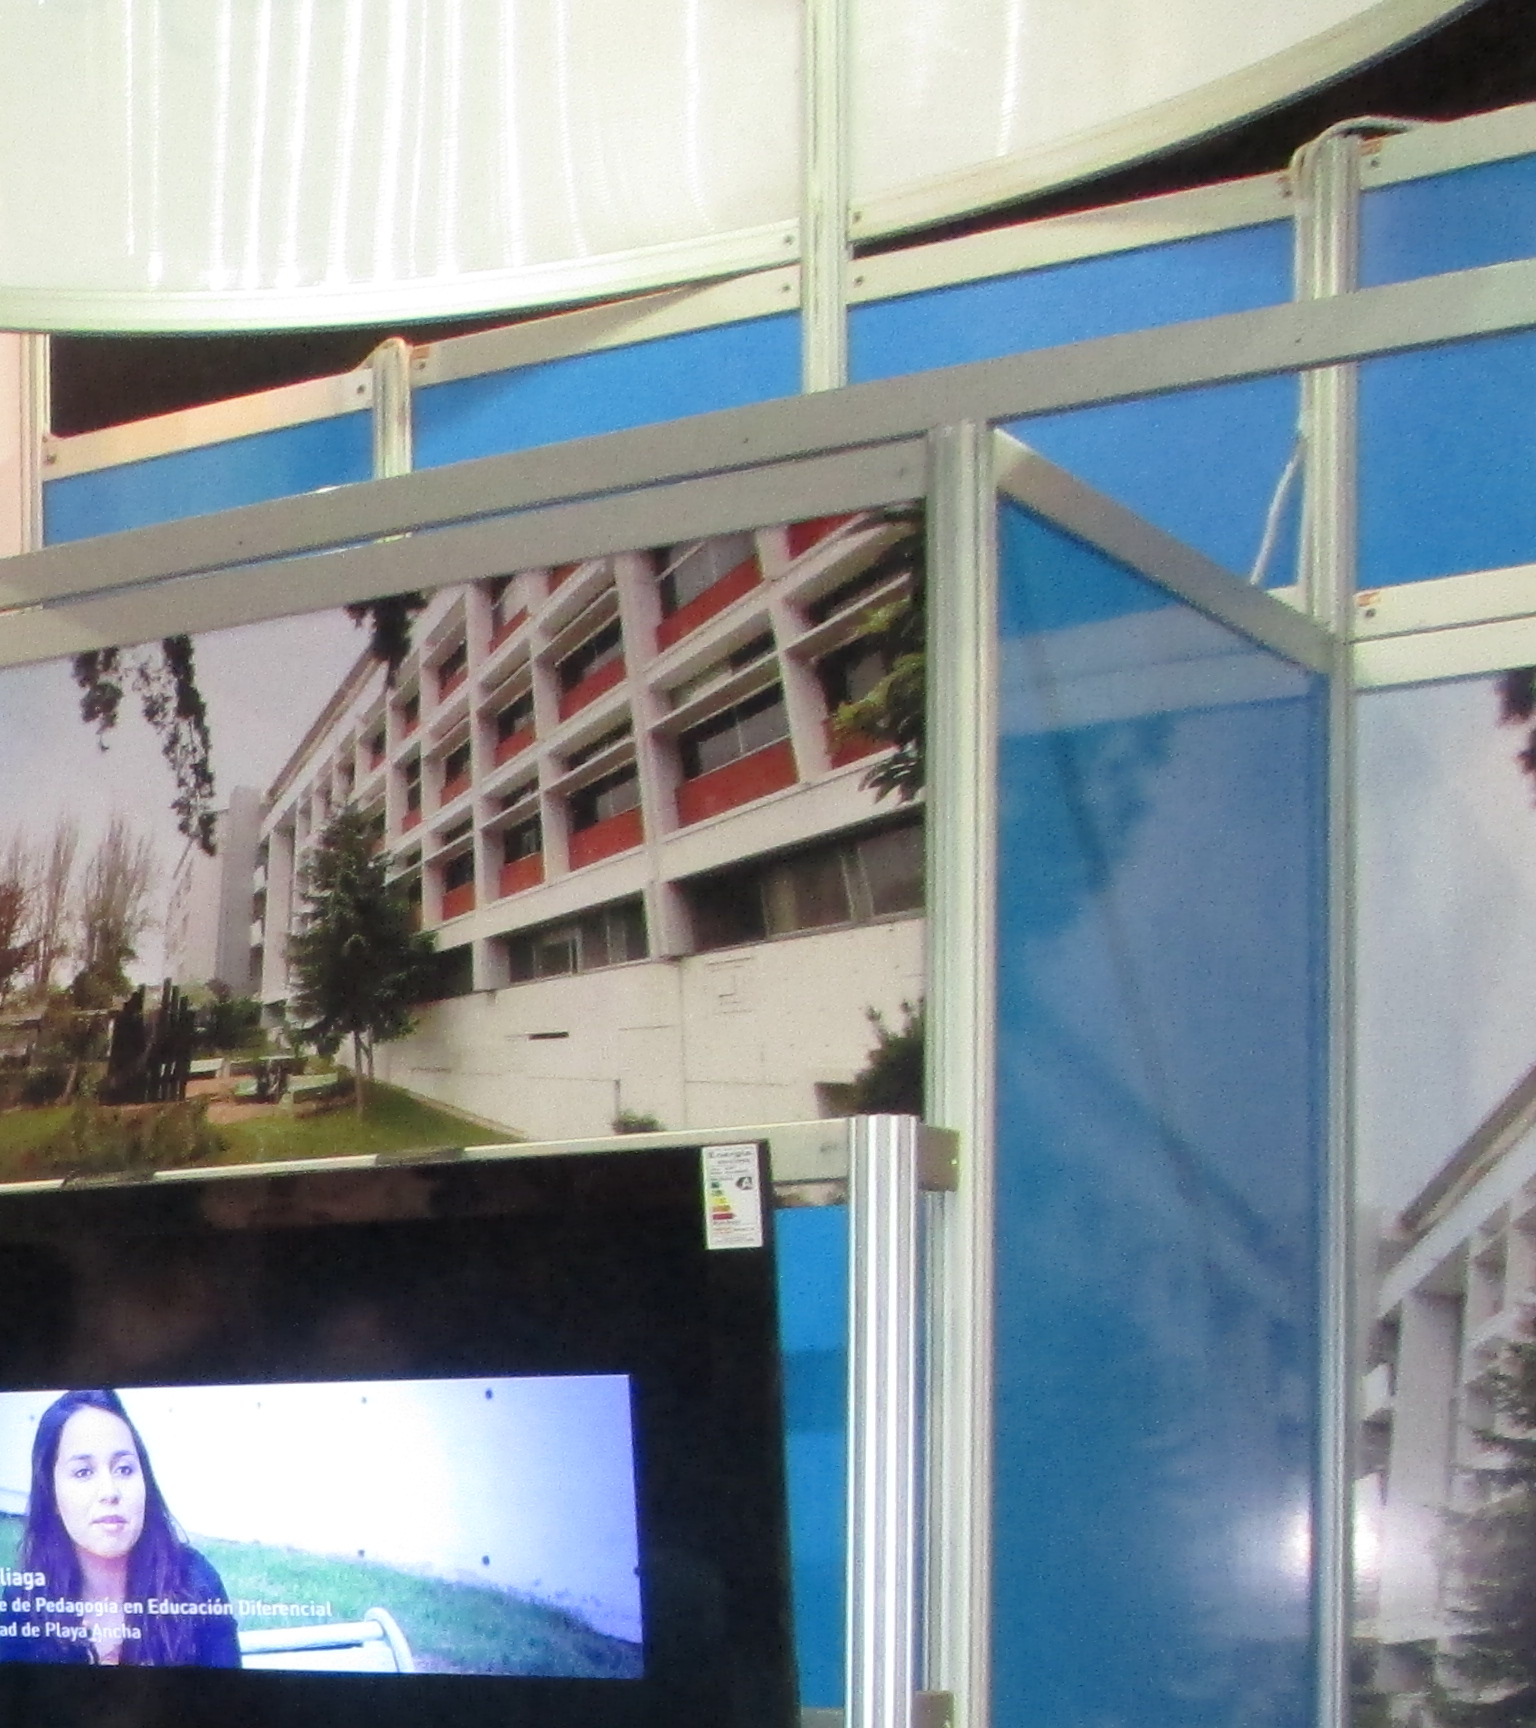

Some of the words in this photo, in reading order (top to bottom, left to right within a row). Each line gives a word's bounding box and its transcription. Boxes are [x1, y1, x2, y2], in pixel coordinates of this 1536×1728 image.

[11, 1597, 31, 1613] de
[35, 1597, 119, 1618] Pedagogía
[123, 1602, 143, 1615] en
[147, 1597, 233, 1616] Educación
[238, 1600, 332, 1617] Diferencial
[21, 1622, 41, 1638] de
[44, 1622, 87, 1643] Playa
[90, 1623, 142, 1640] Ancha
